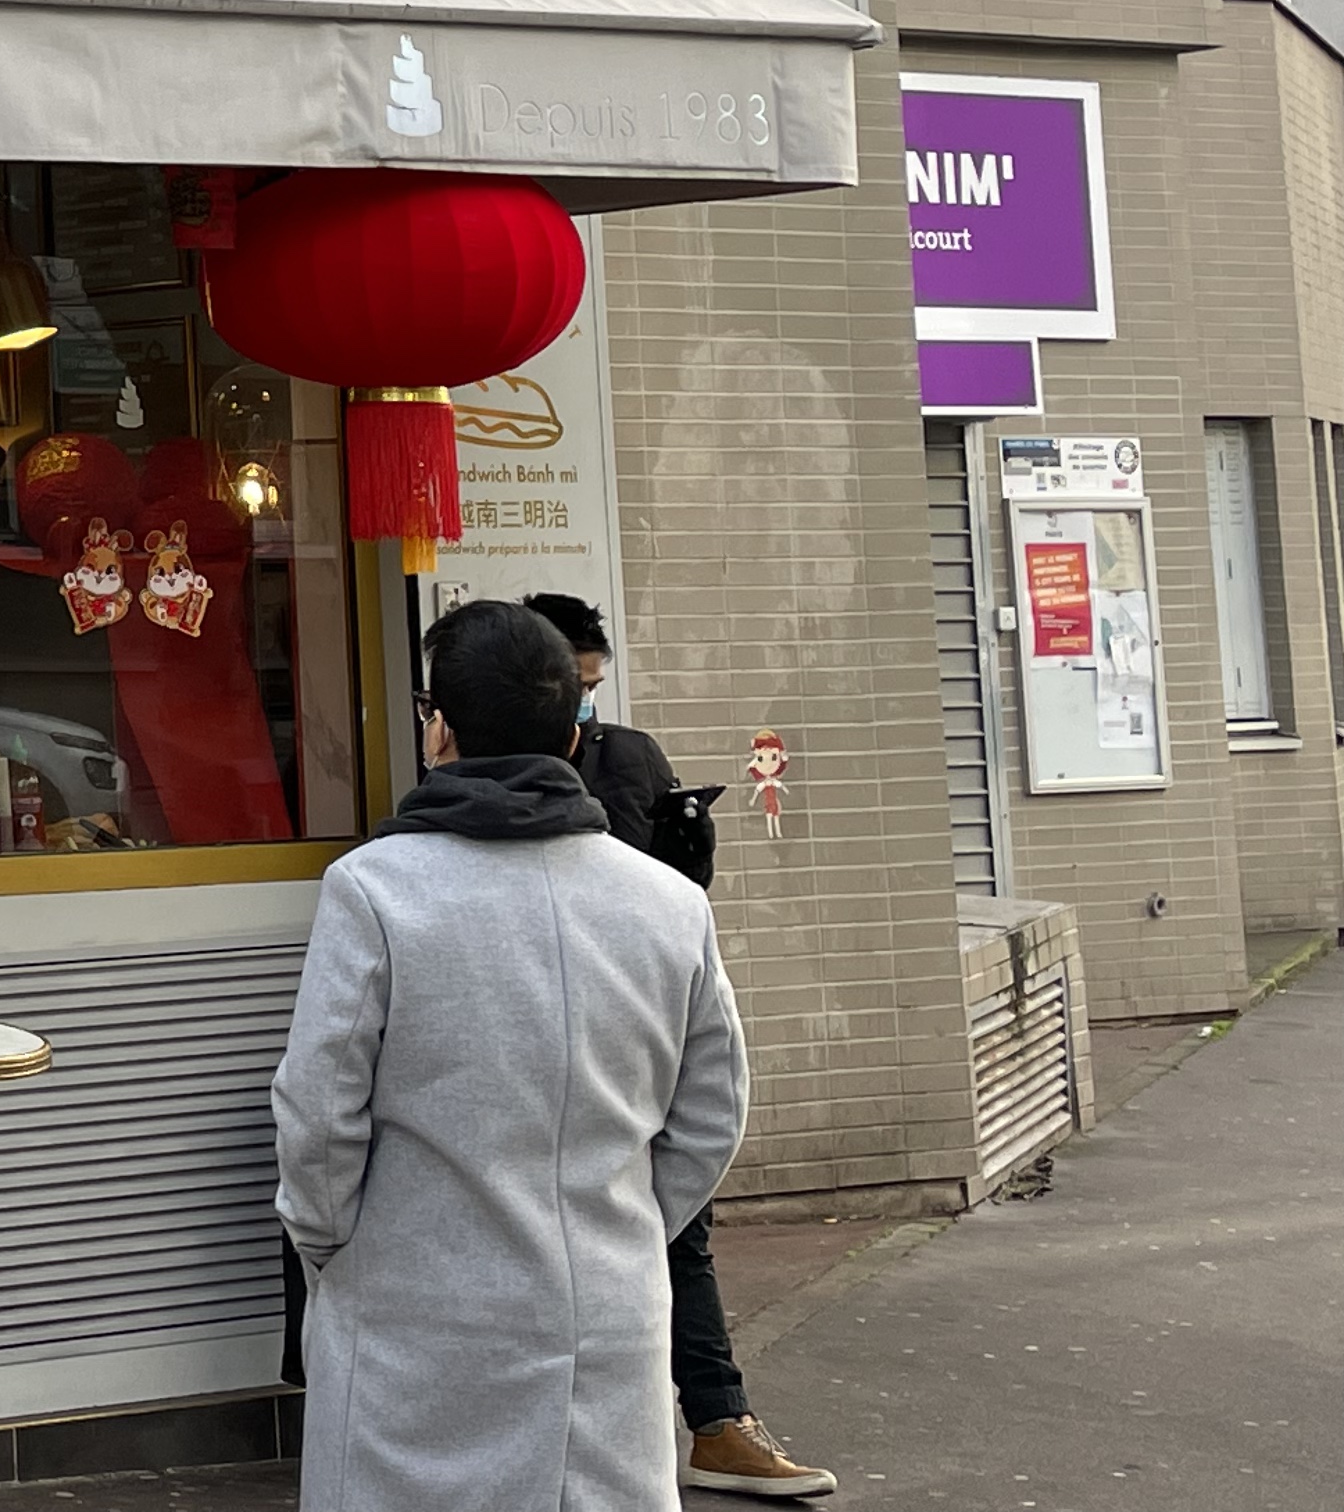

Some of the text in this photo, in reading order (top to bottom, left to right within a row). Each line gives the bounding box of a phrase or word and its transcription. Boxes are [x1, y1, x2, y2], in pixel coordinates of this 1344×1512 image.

[479, 83, 770, 148] Depuis 1983
[905, 150, 1014, 206] NIM'
[458, 463, 511, 483] ndwich
